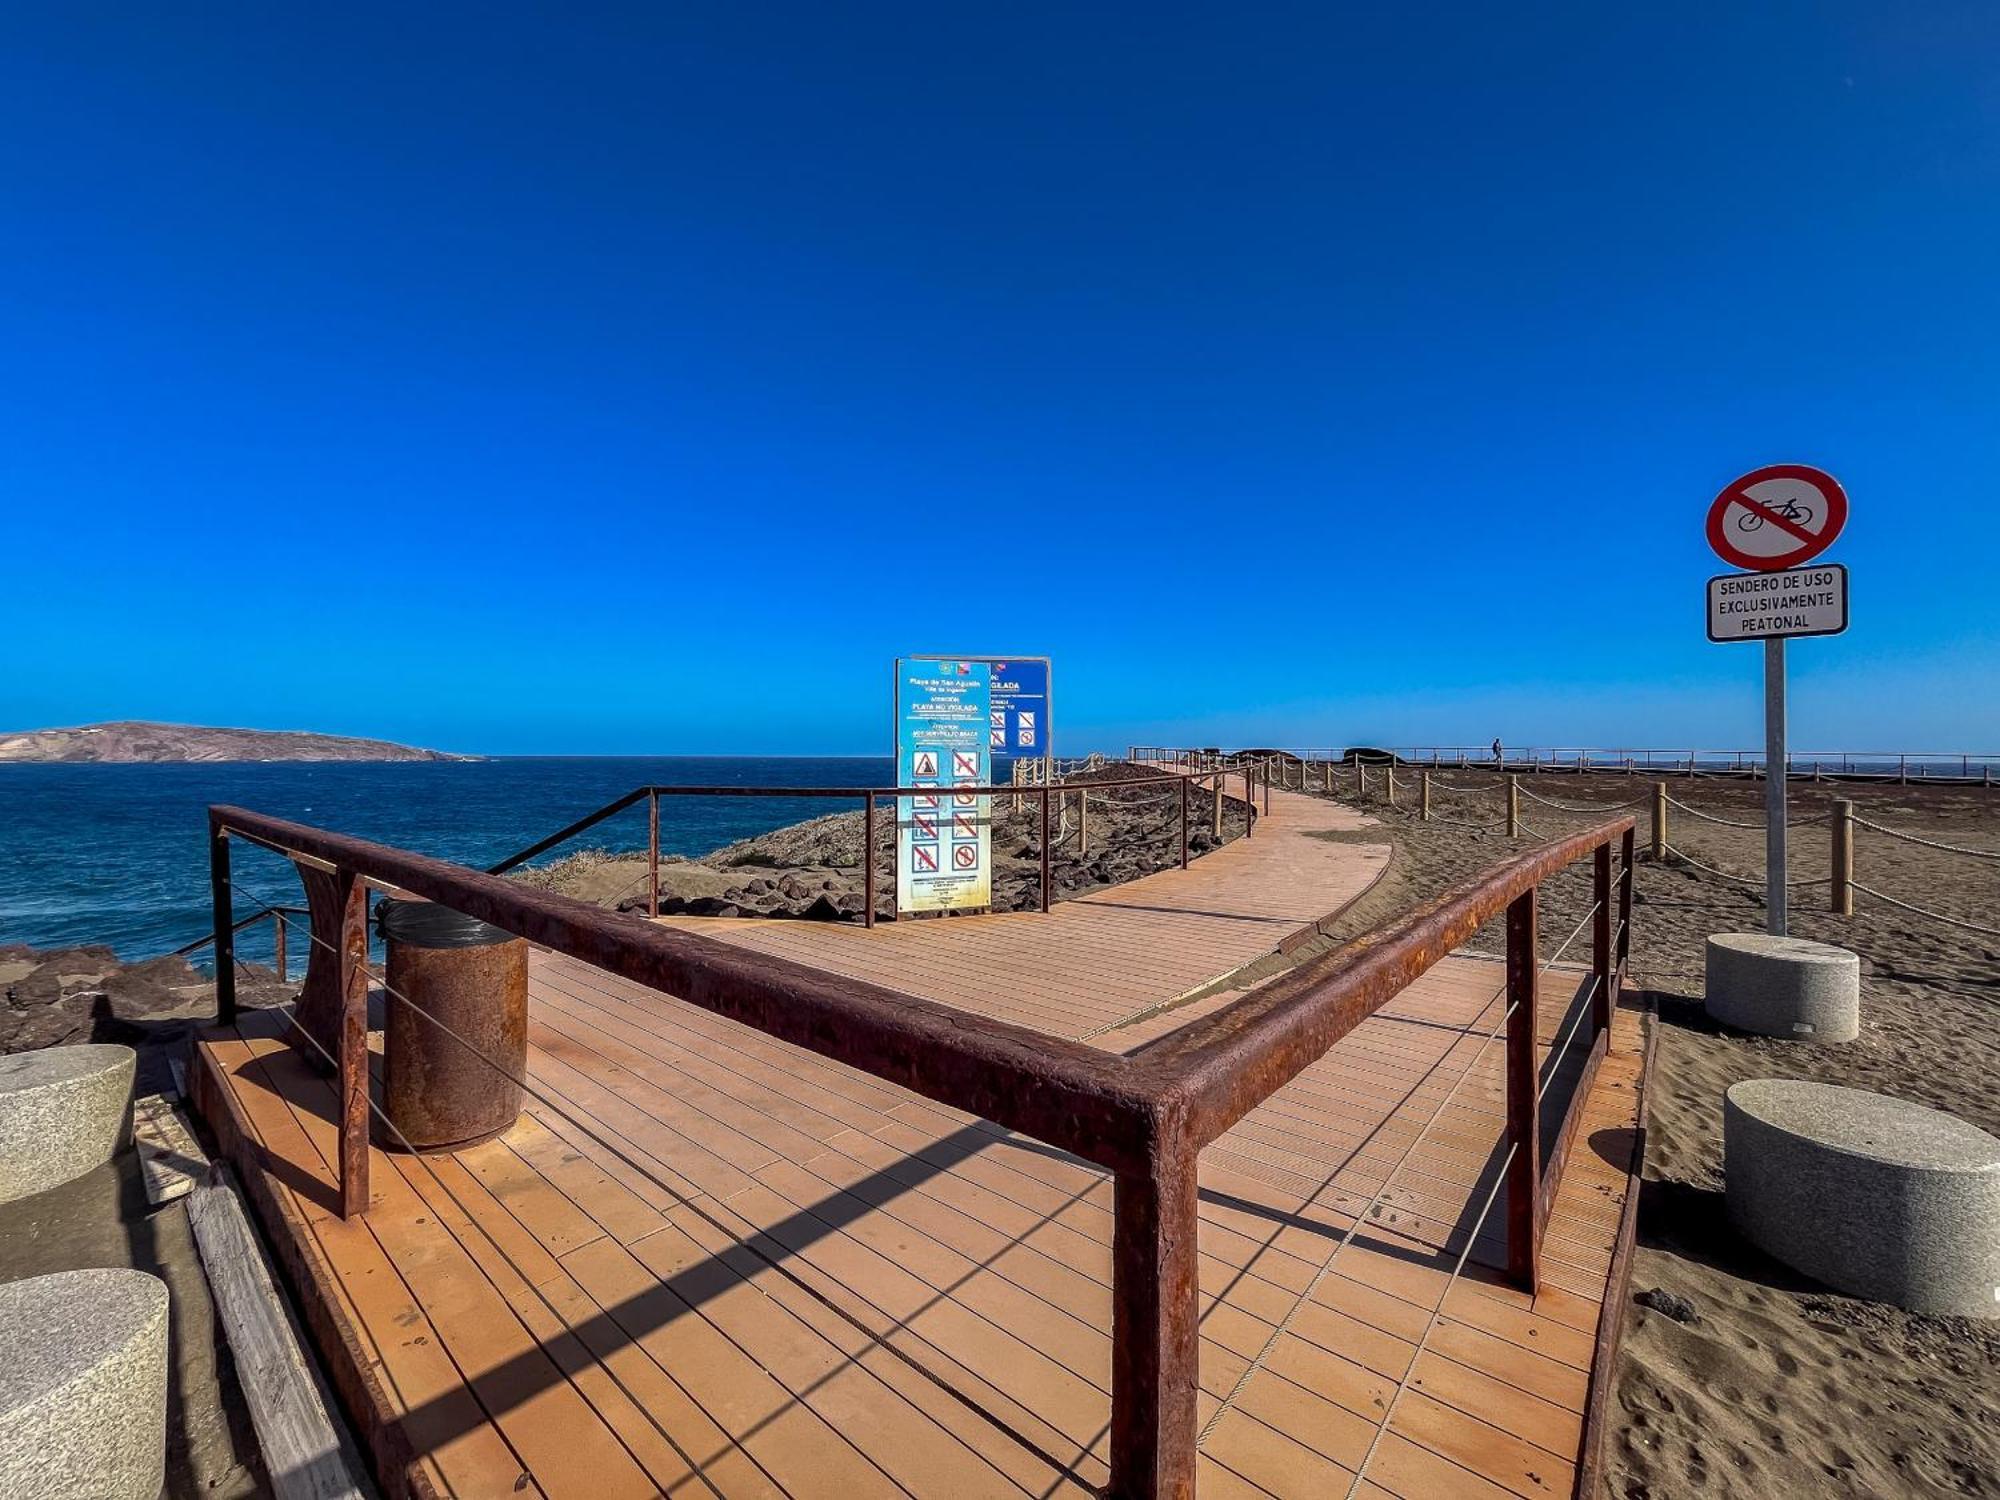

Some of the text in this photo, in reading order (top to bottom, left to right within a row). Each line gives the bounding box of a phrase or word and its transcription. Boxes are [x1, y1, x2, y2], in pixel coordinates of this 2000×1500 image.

[1720, 572, 1833, 595] SENDERO DE USO
[1719, 592, 1834, 614] EXCLUSIVAMENTE
[1742, 614, 1809, 632] PEATONAL
